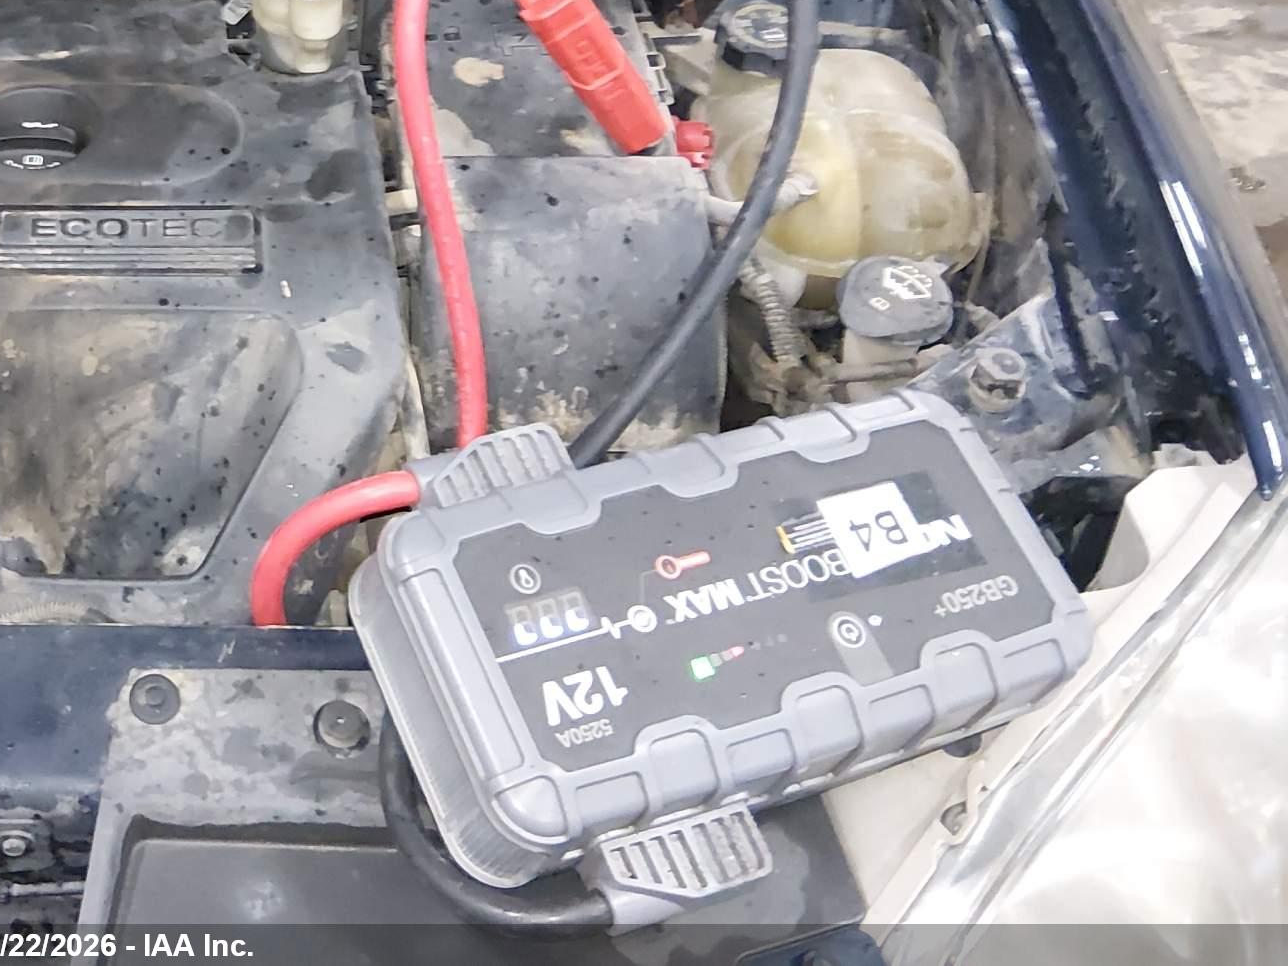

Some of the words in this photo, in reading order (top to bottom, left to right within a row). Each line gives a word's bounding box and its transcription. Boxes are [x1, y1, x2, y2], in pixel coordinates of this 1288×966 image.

[30, 216, 223, 239] ECOTEC
[848, 509, 909, 553] B4
[748, 548, 852, 602] BOOST
[933, 575, 1019, 618] GB250+
[664, 578, 745, 623] MAX
[541, 665, 629, 726] 12V
[554, 718, 613, 748] 5250A
